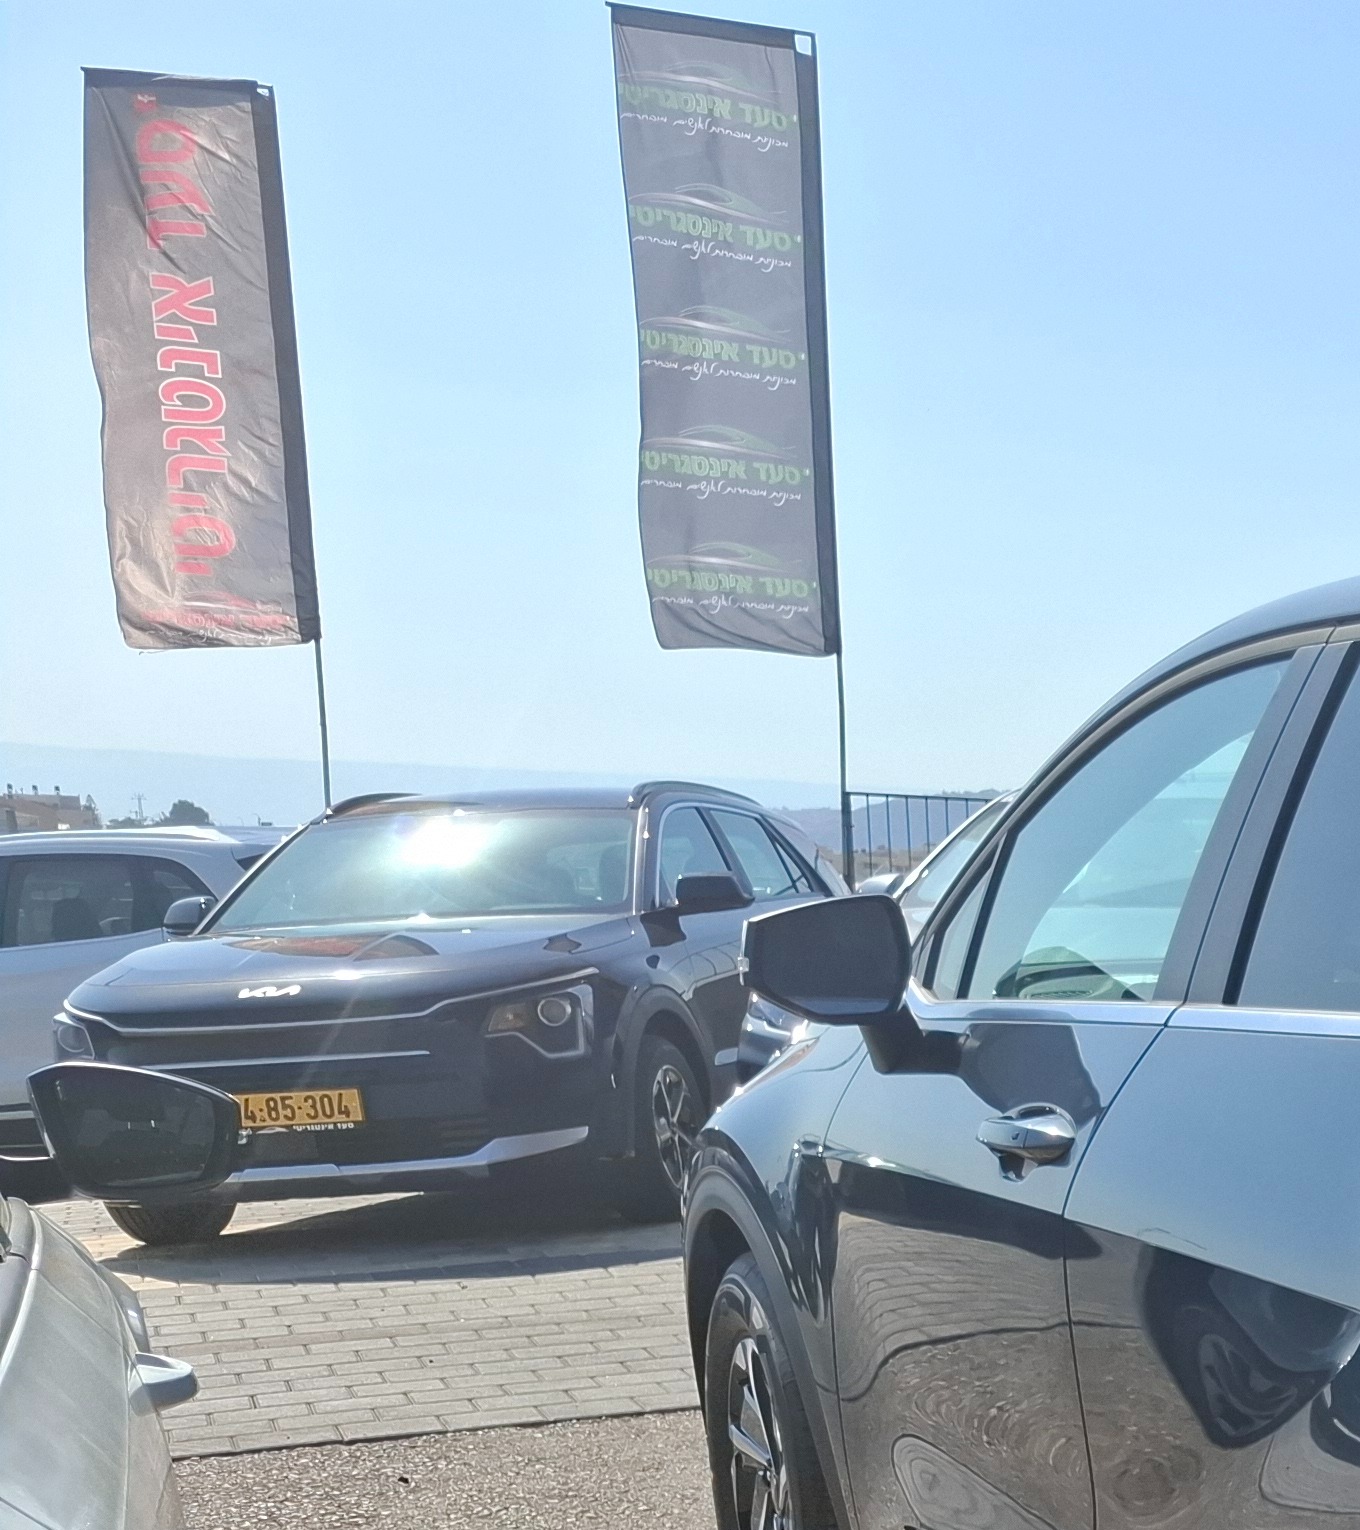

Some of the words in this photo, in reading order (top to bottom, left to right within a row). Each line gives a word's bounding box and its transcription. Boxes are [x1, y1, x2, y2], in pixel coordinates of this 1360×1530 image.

[738, 102, 788, 132] סעד
[136, 117, 214, 250] סעד
[739, 224, 793, 251] סעד
[745, 344, 796, 369] סעד
[149, 272, 237, 576] אינטגריטי
[753, 461, 802, 485] סעד
[758, 576, 809, 598] סעד
